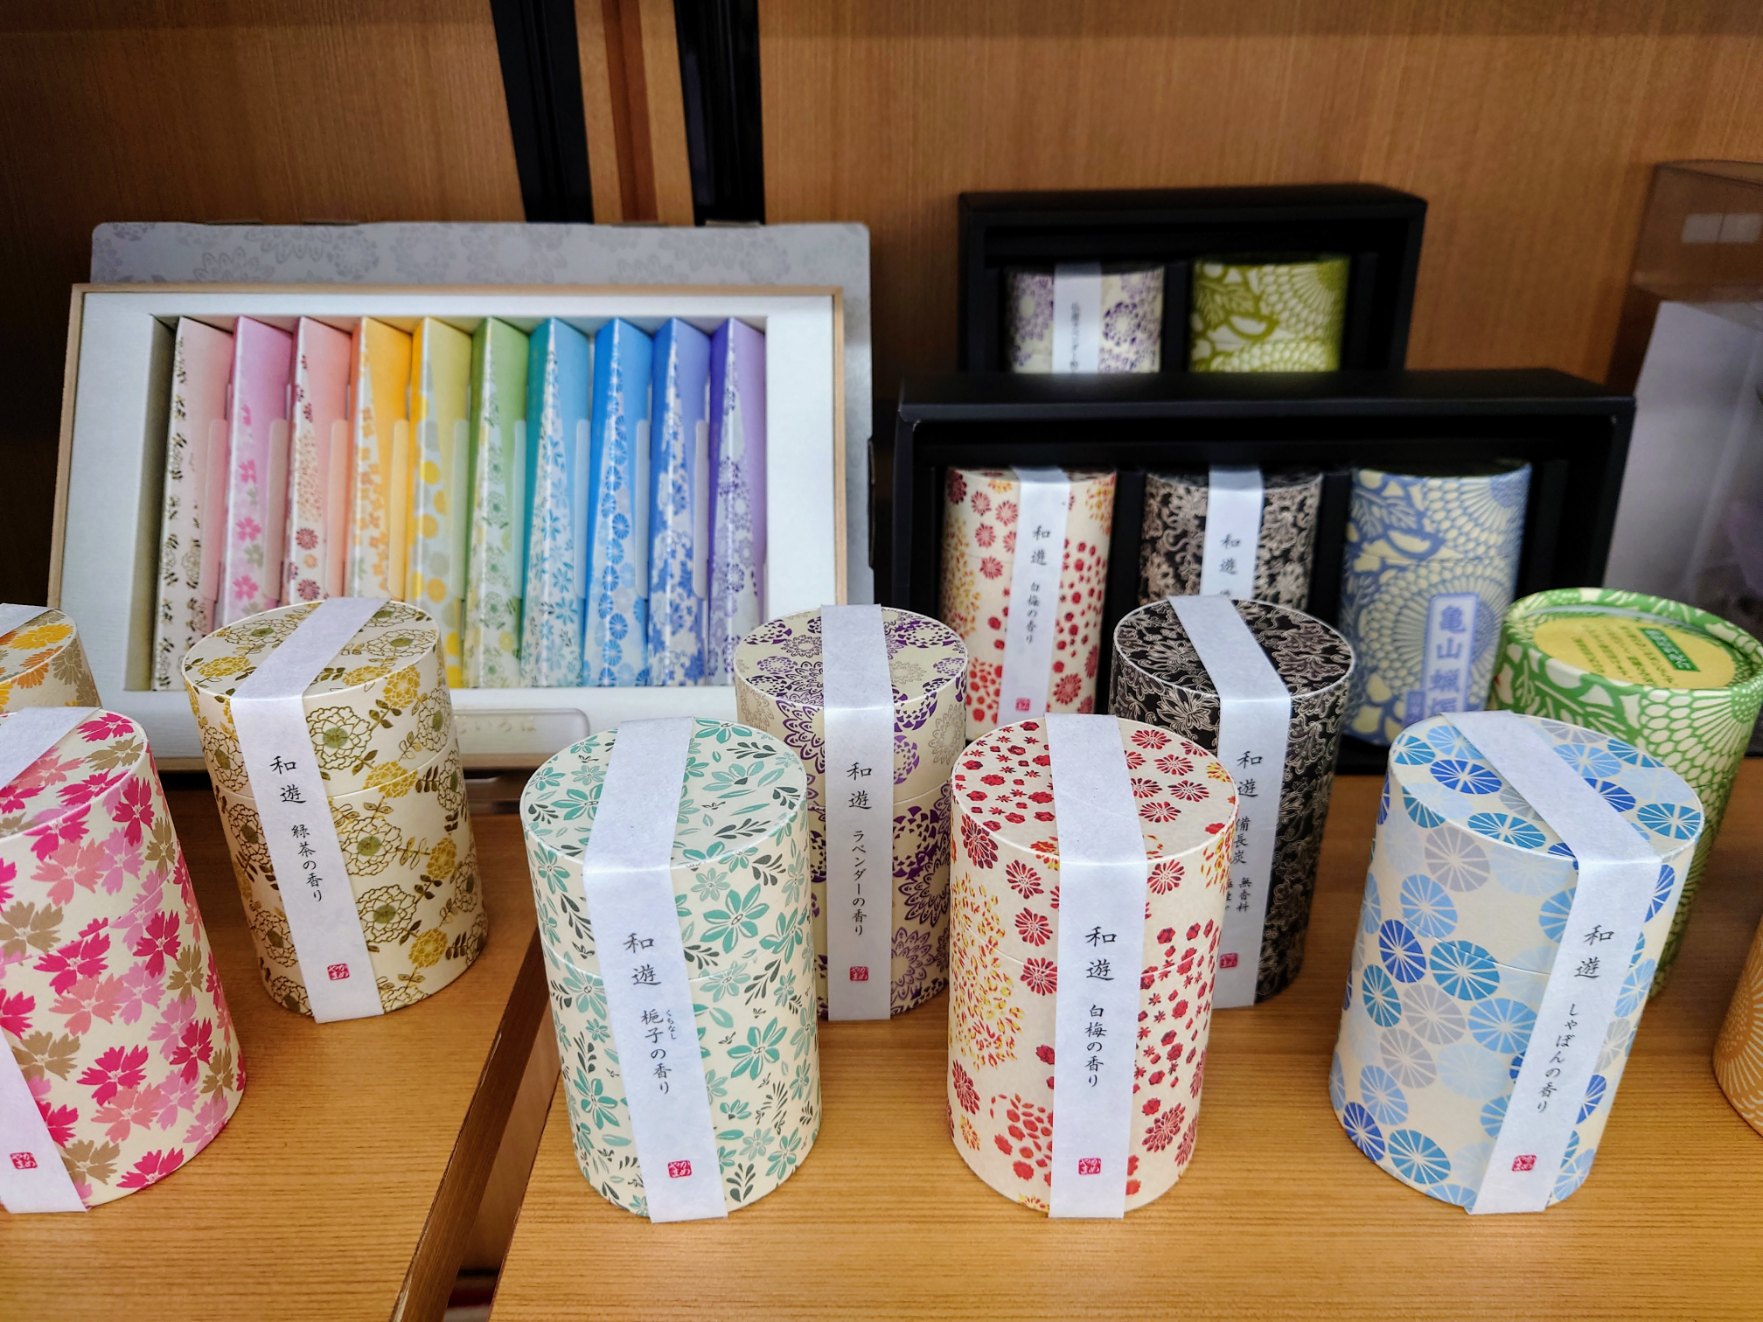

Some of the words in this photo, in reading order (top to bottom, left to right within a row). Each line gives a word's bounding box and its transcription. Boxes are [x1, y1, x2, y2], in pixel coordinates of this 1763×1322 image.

[1031, 525, 1051, 566] 和遊
[846, 761, 873, 810] 和遊
[1237, 751, 1264, 798] 和遊
[270, 755, 307, 804] 和遊
[291, 824, 324, 903] 緑茶の香り
[623, 932, 662, 986] 和遊
[1085, 925, 1117, 982] 和遊
[1574, 924, 1615, 980] 和遊
[666, 1009, 677, 1040] くちなし
[1084, 1004, 1107, 1088] 白梅の香り
[1537, 1003, 1579, 1114] しゃぼんの香り
